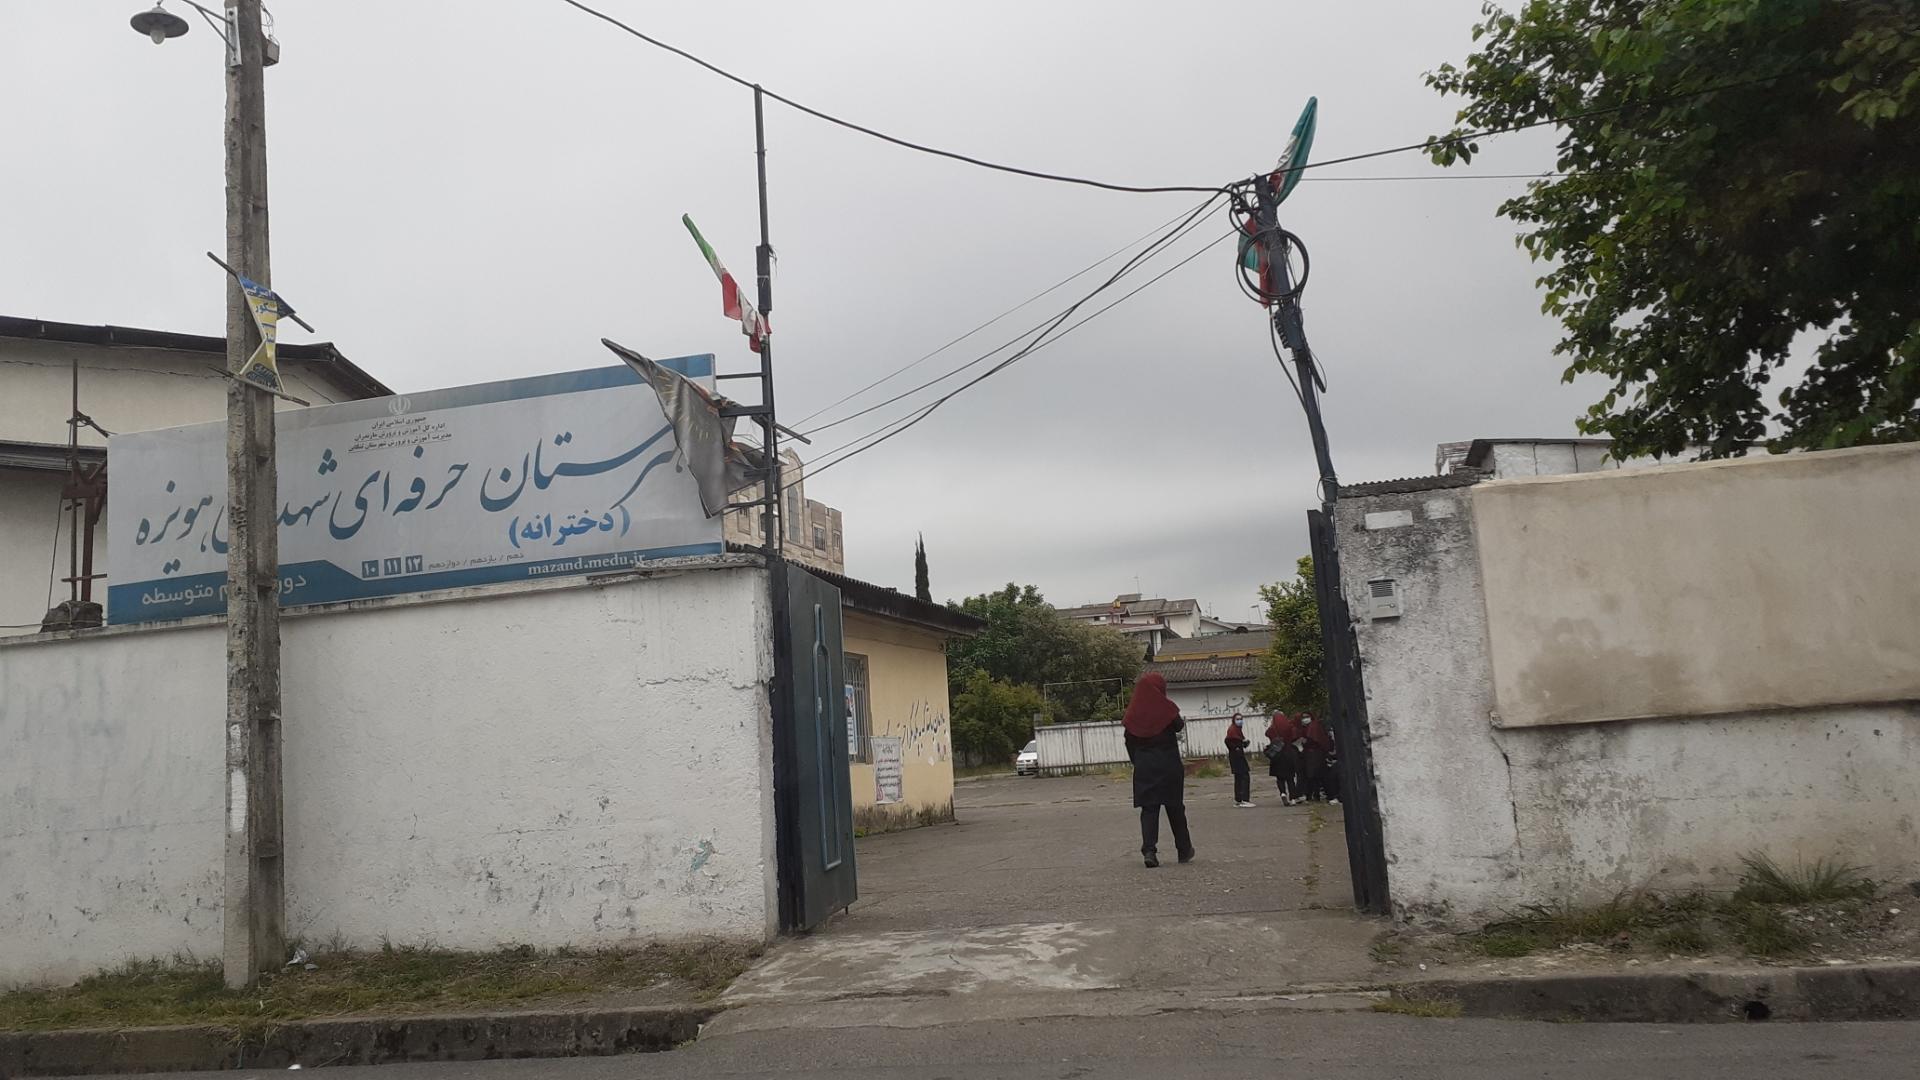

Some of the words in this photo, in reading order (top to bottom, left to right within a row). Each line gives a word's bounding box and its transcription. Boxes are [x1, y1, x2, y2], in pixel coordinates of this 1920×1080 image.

[386, 418, 405, 427] اسلامی
[392, 445, 469, 517] حرفه
[135, 480, 214, 575] هویزه
[527, 553, 646, 576] mazand.medu.ir
[141, 583, 214, 606] متوسطه
